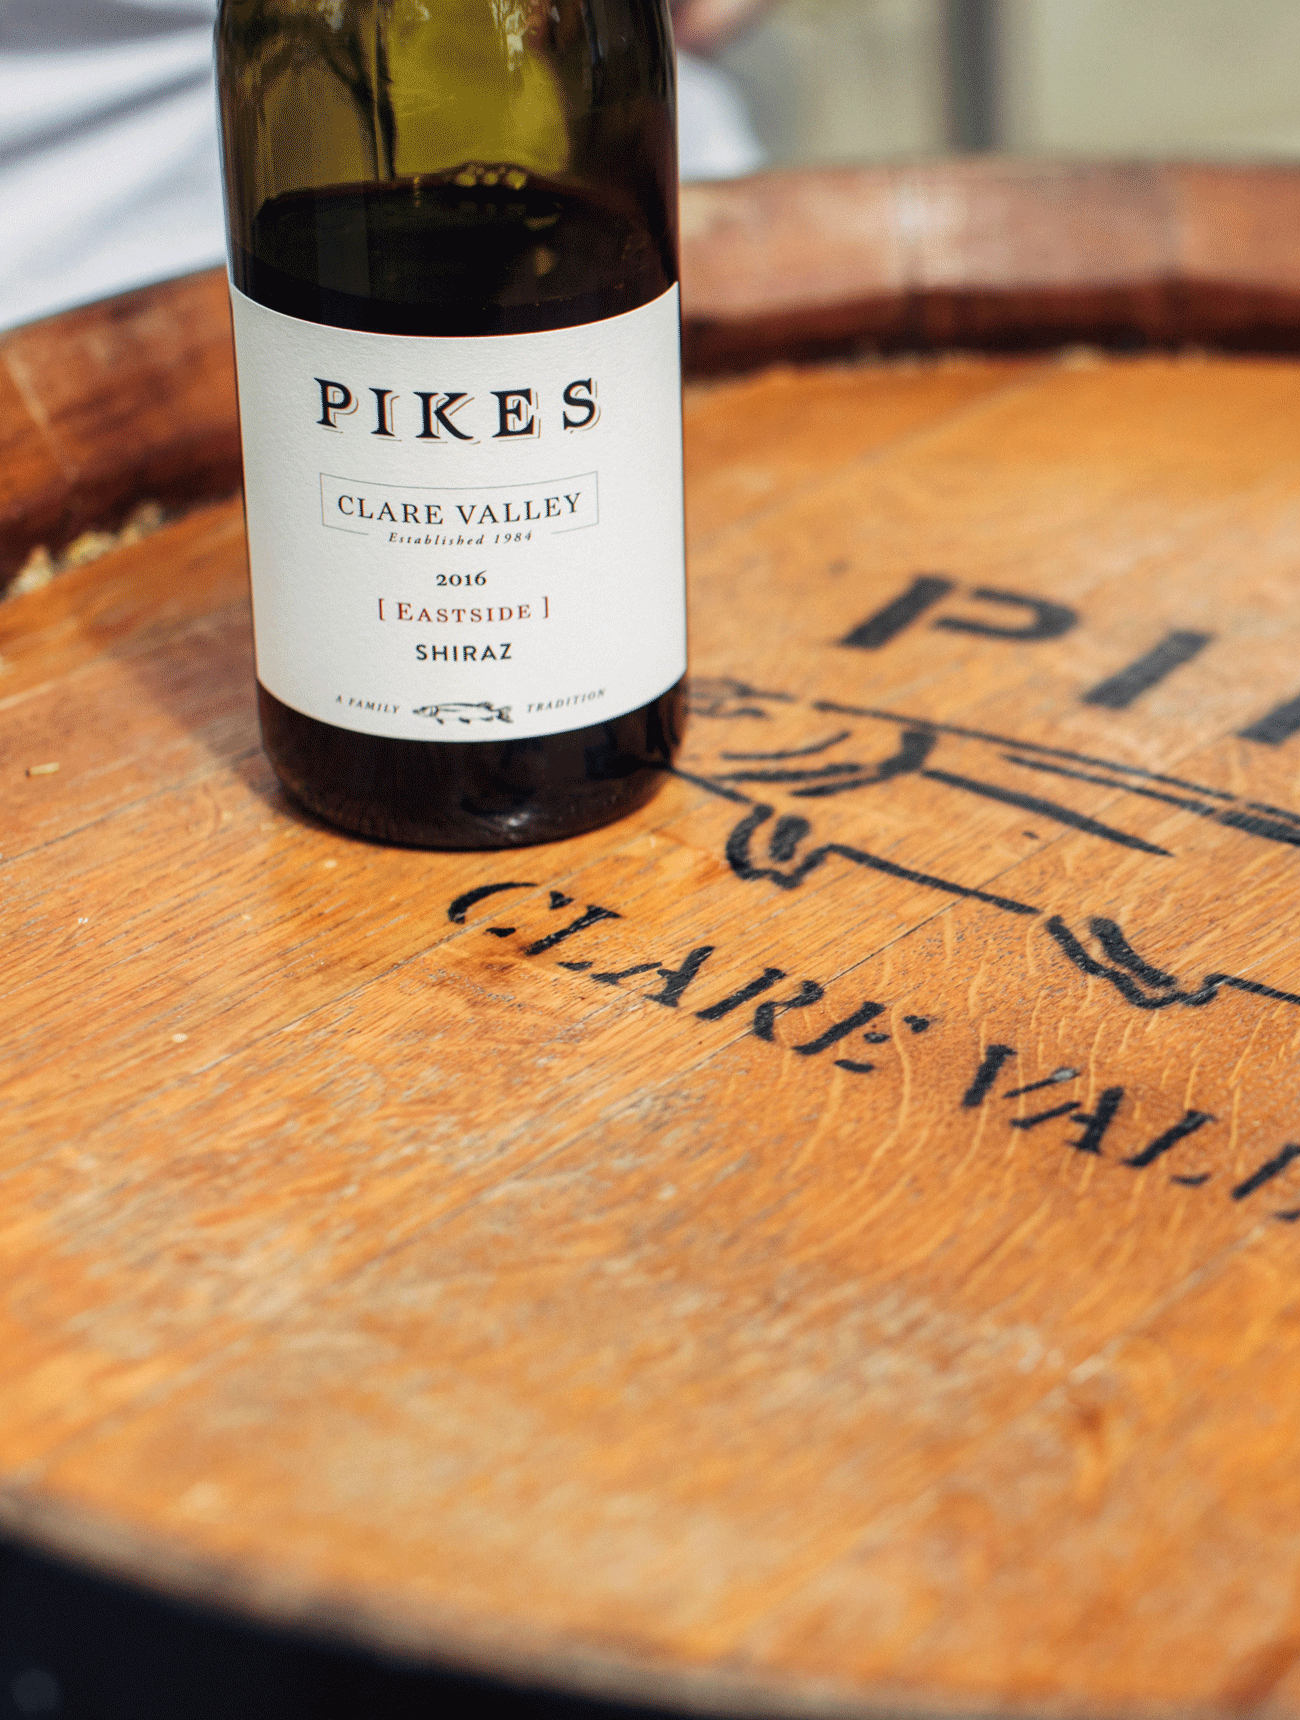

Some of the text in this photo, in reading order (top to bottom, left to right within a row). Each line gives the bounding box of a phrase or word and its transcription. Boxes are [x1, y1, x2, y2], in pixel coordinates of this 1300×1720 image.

[314, 378, 600, 443] PIKES
[338, 492, 581, 525] CLARE VALLEY
[388, 530, 532, 546] Established 1984
[436, 571, 487, 586] 2016
[416, 643, 512, 661] SHIRAZ
[335, 688, 606, 714] A FAMILY TRADITION
[447, 882, 931, 1073] CLARE
